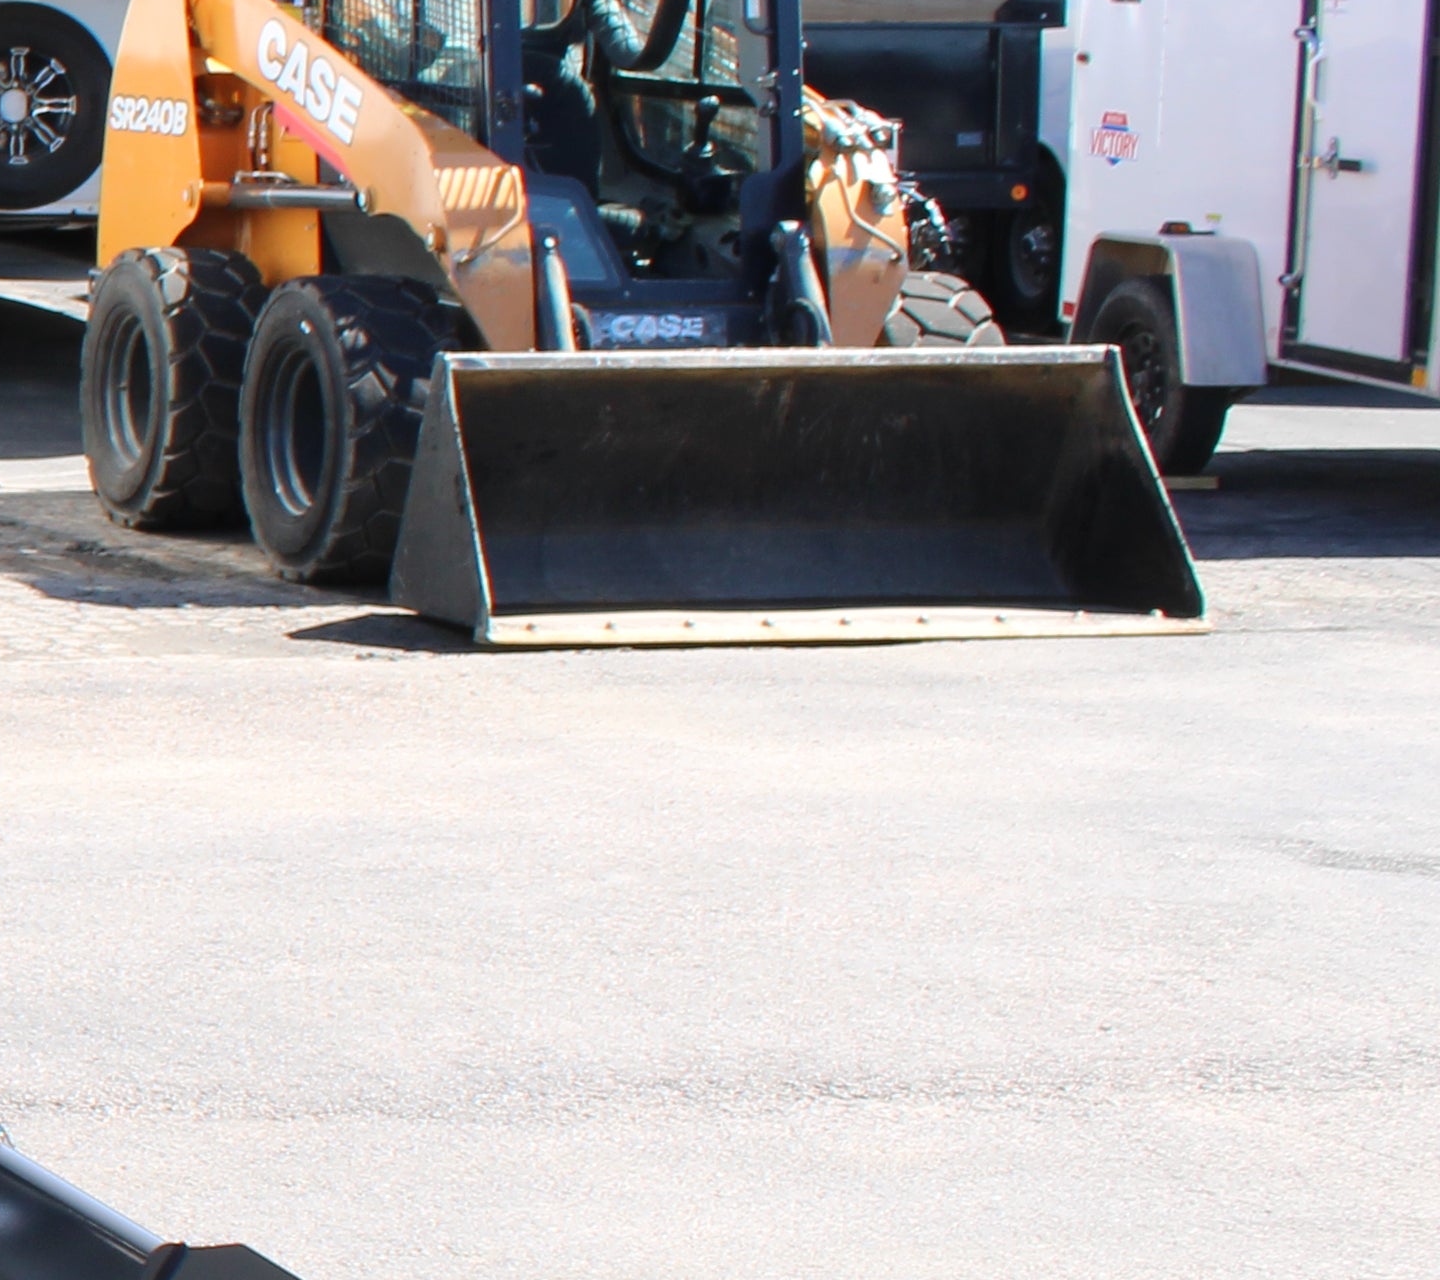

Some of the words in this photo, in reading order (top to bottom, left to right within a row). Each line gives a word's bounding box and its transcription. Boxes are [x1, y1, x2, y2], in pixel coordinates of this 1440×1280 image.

[256, 18, 364, 146] CASE
[110, 95, 189, 137] SR240B
[1090, 127, 1141, 160] VICTORY
[610, 314, 704, 340] CASE
